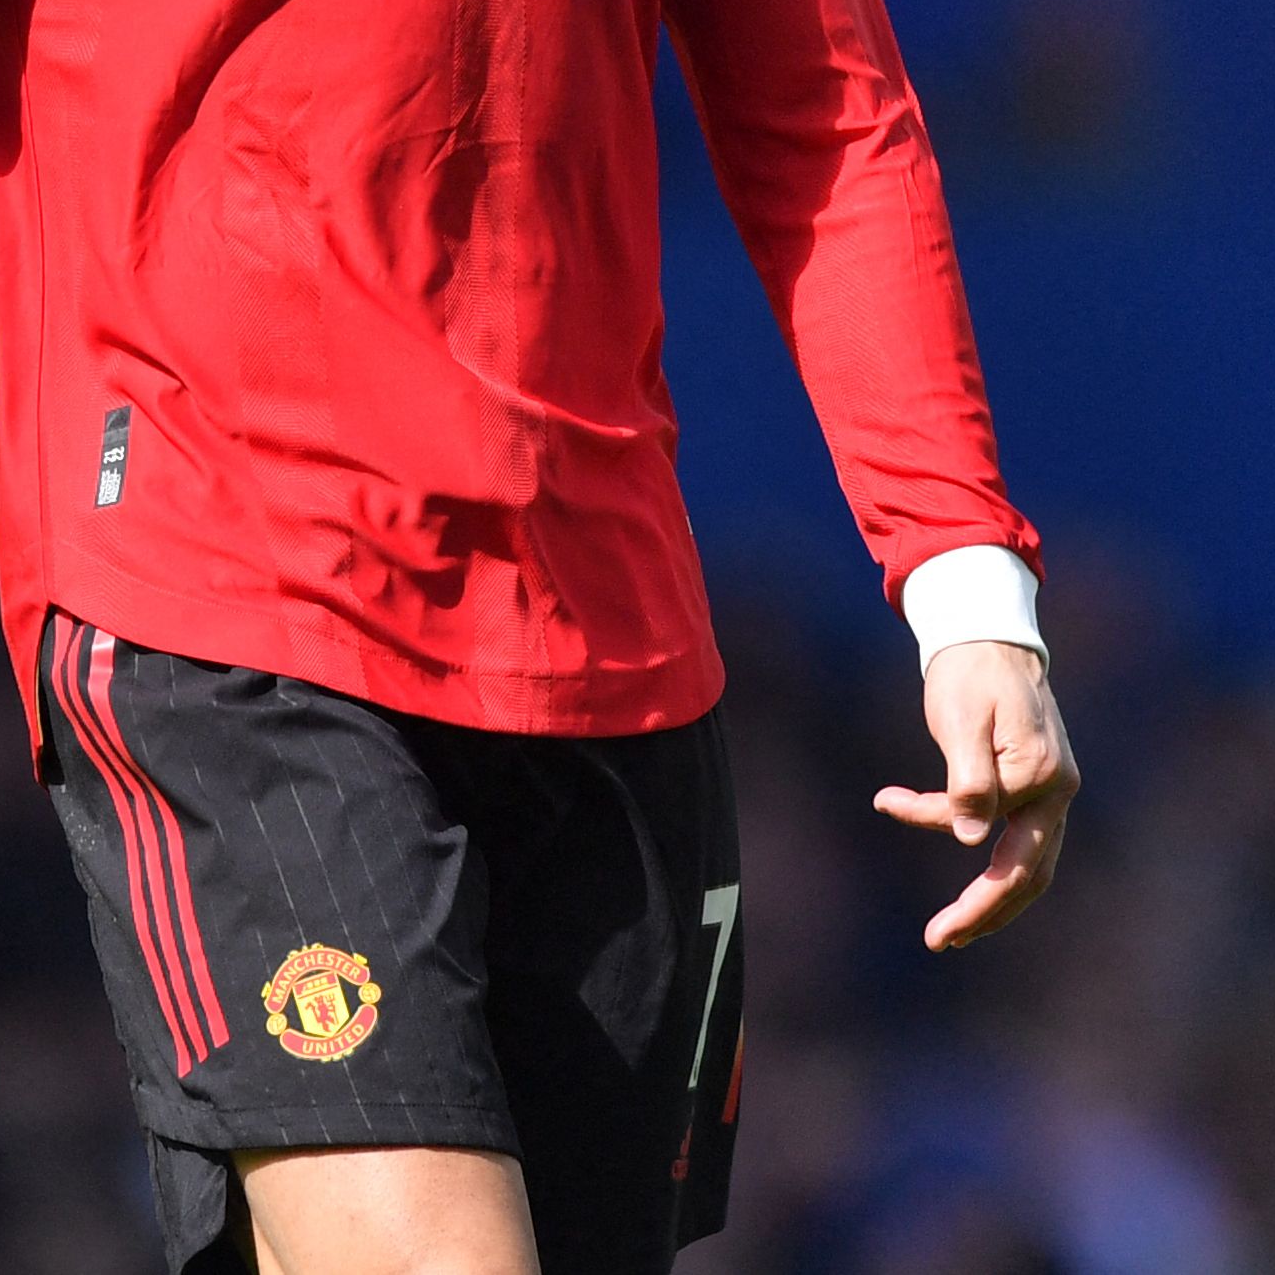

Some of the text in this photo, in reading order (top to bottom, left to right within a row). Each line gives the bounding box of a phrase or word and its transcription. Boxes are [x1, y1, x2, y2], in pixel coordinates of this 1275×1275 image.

[271, 952, 361, 1004] MANCHESTER
[687, 883, 740, 1090] 7
[302, 1024, 365, 1054] UNITED
